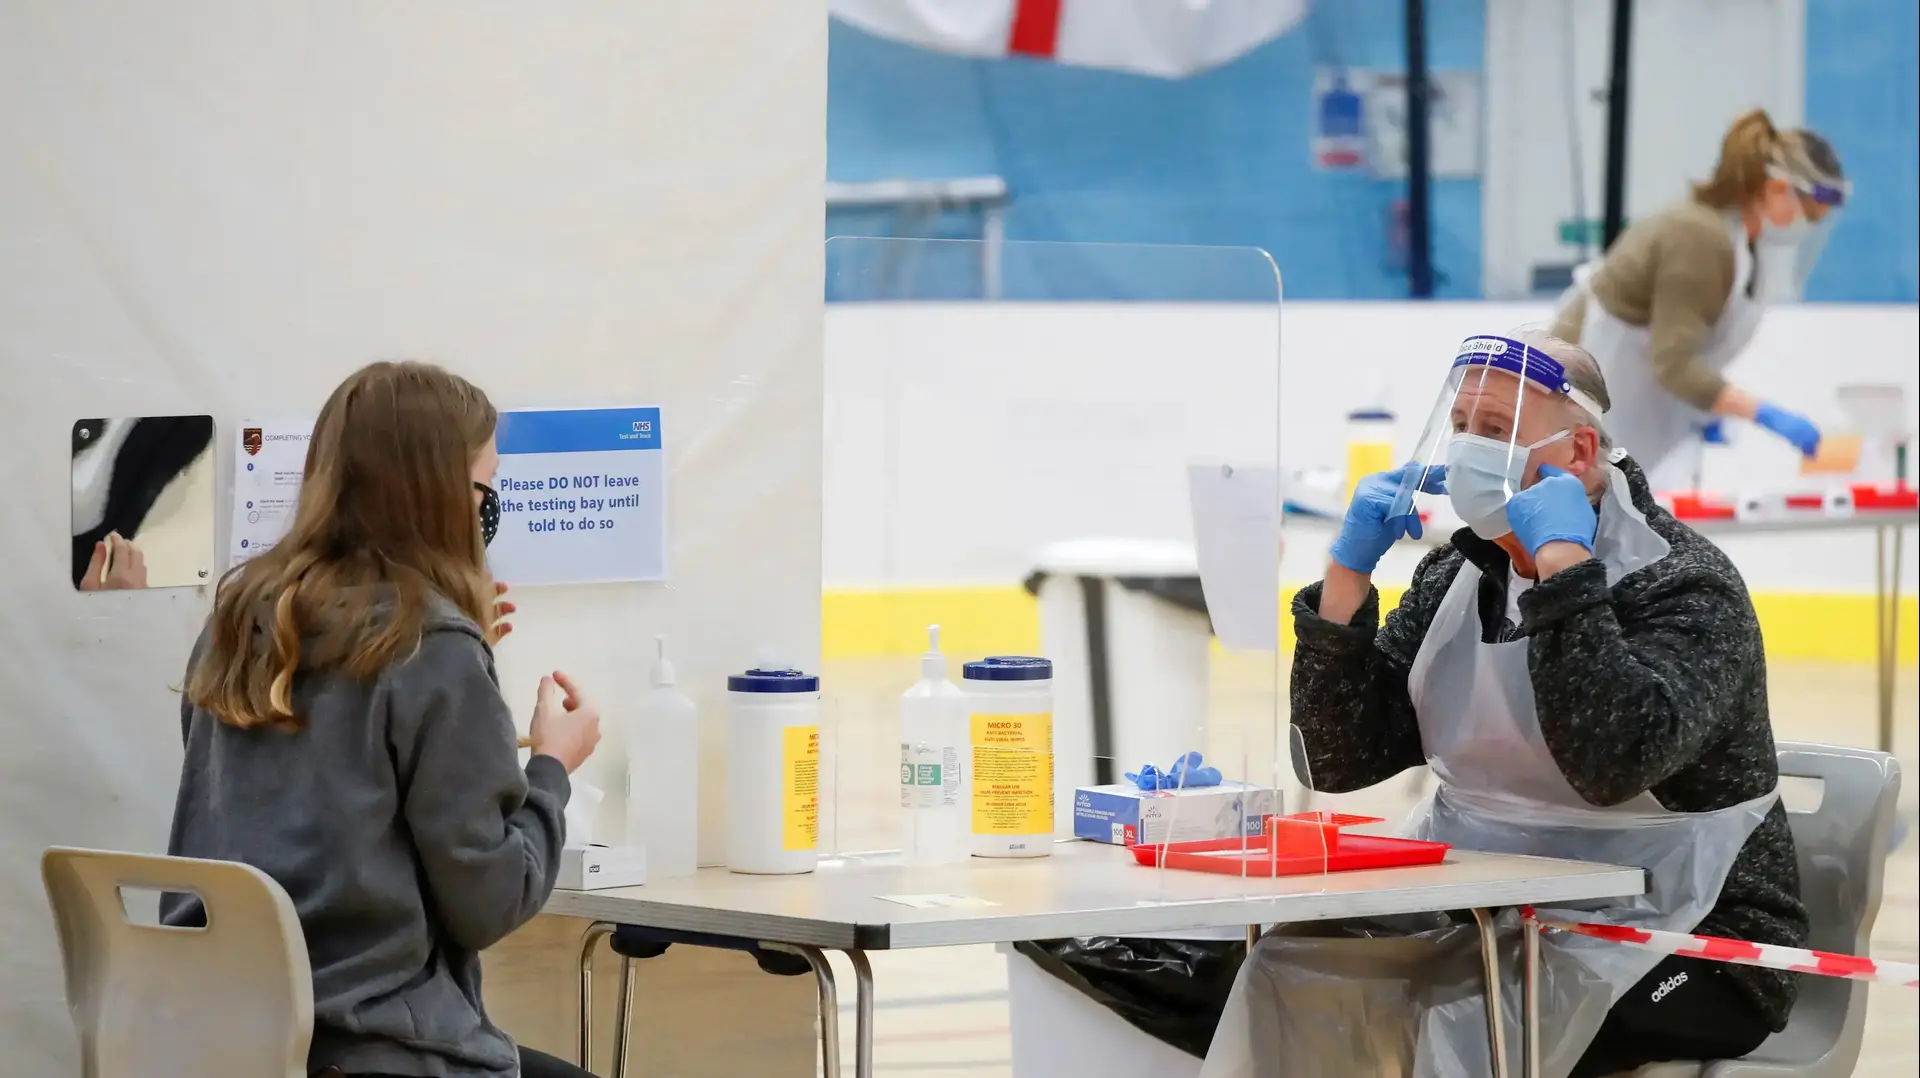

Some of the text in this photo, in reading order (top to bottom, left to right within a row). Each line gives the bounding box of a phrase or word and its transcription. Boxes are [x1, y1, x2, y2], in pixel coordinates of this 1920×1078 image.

[1473, 342, 1503, 351] Shield
[634, 422, 650, 431] NHS
[501, 475, 639, 491] Please DO NOT leave
[501, 494, 639, 513] the testing bay until
[528, 517, 614, 532] told to do so
[1246, 821, 1260, 830] 100
[1113, 828, 1134, 838] 100 XL
[1651, 971, 1688, 1002] adidas
